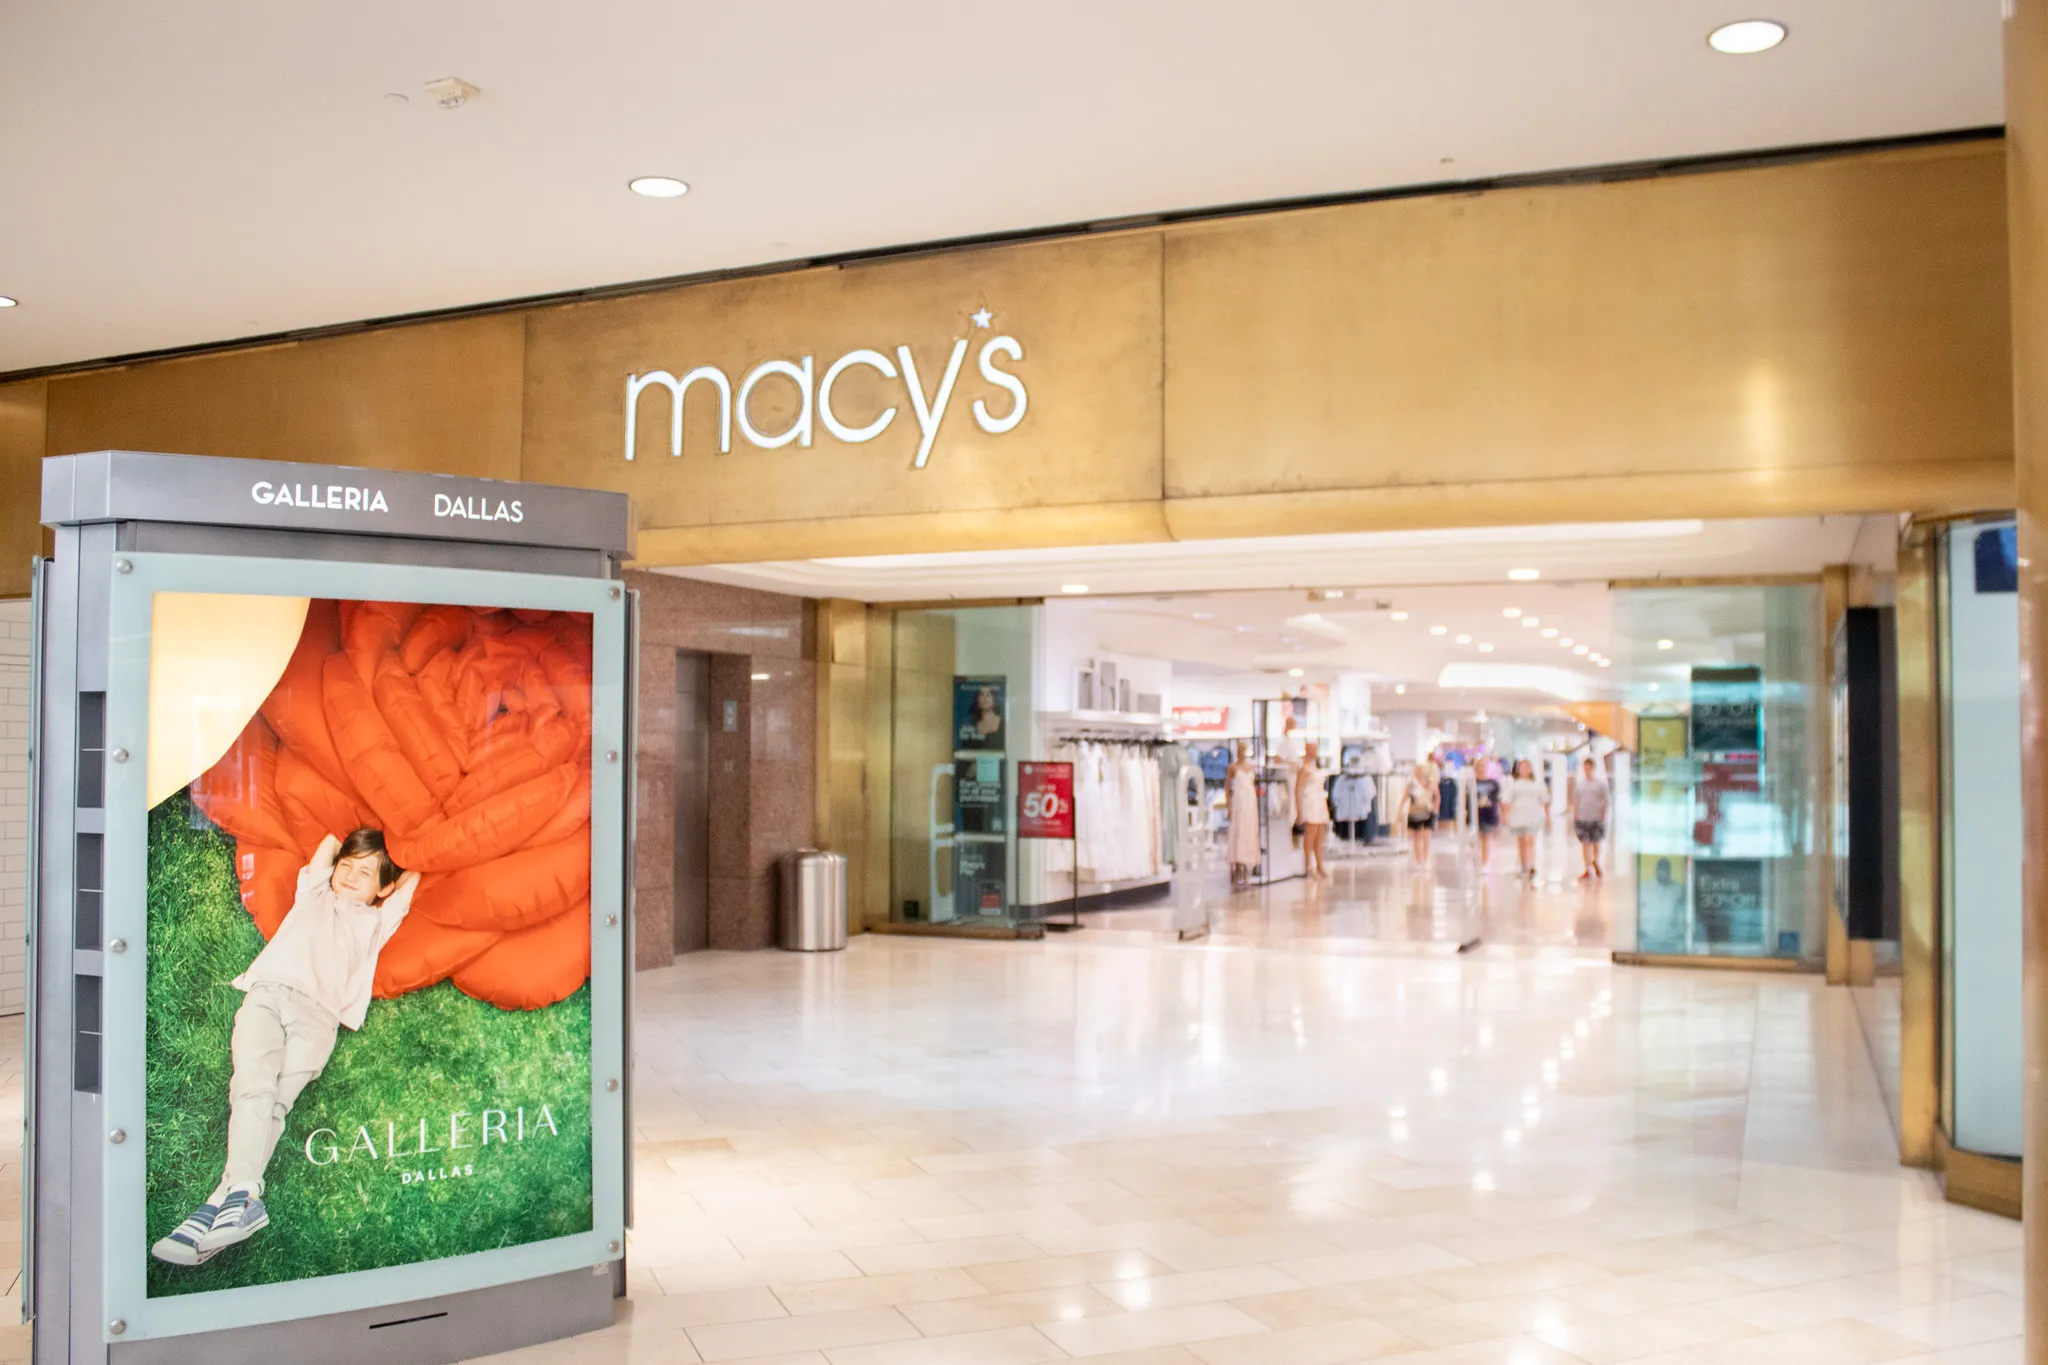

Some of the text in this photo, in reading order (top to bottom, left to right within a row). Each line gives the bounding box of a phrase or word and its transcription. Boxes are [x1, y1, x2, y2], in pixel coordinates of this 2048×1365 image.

[251, 481, 524, 523] GALLERIA DALLAS
[304, 1103, 559, 1166] GALLERIA
[402, 1164, 474, 1185] DALLAS
